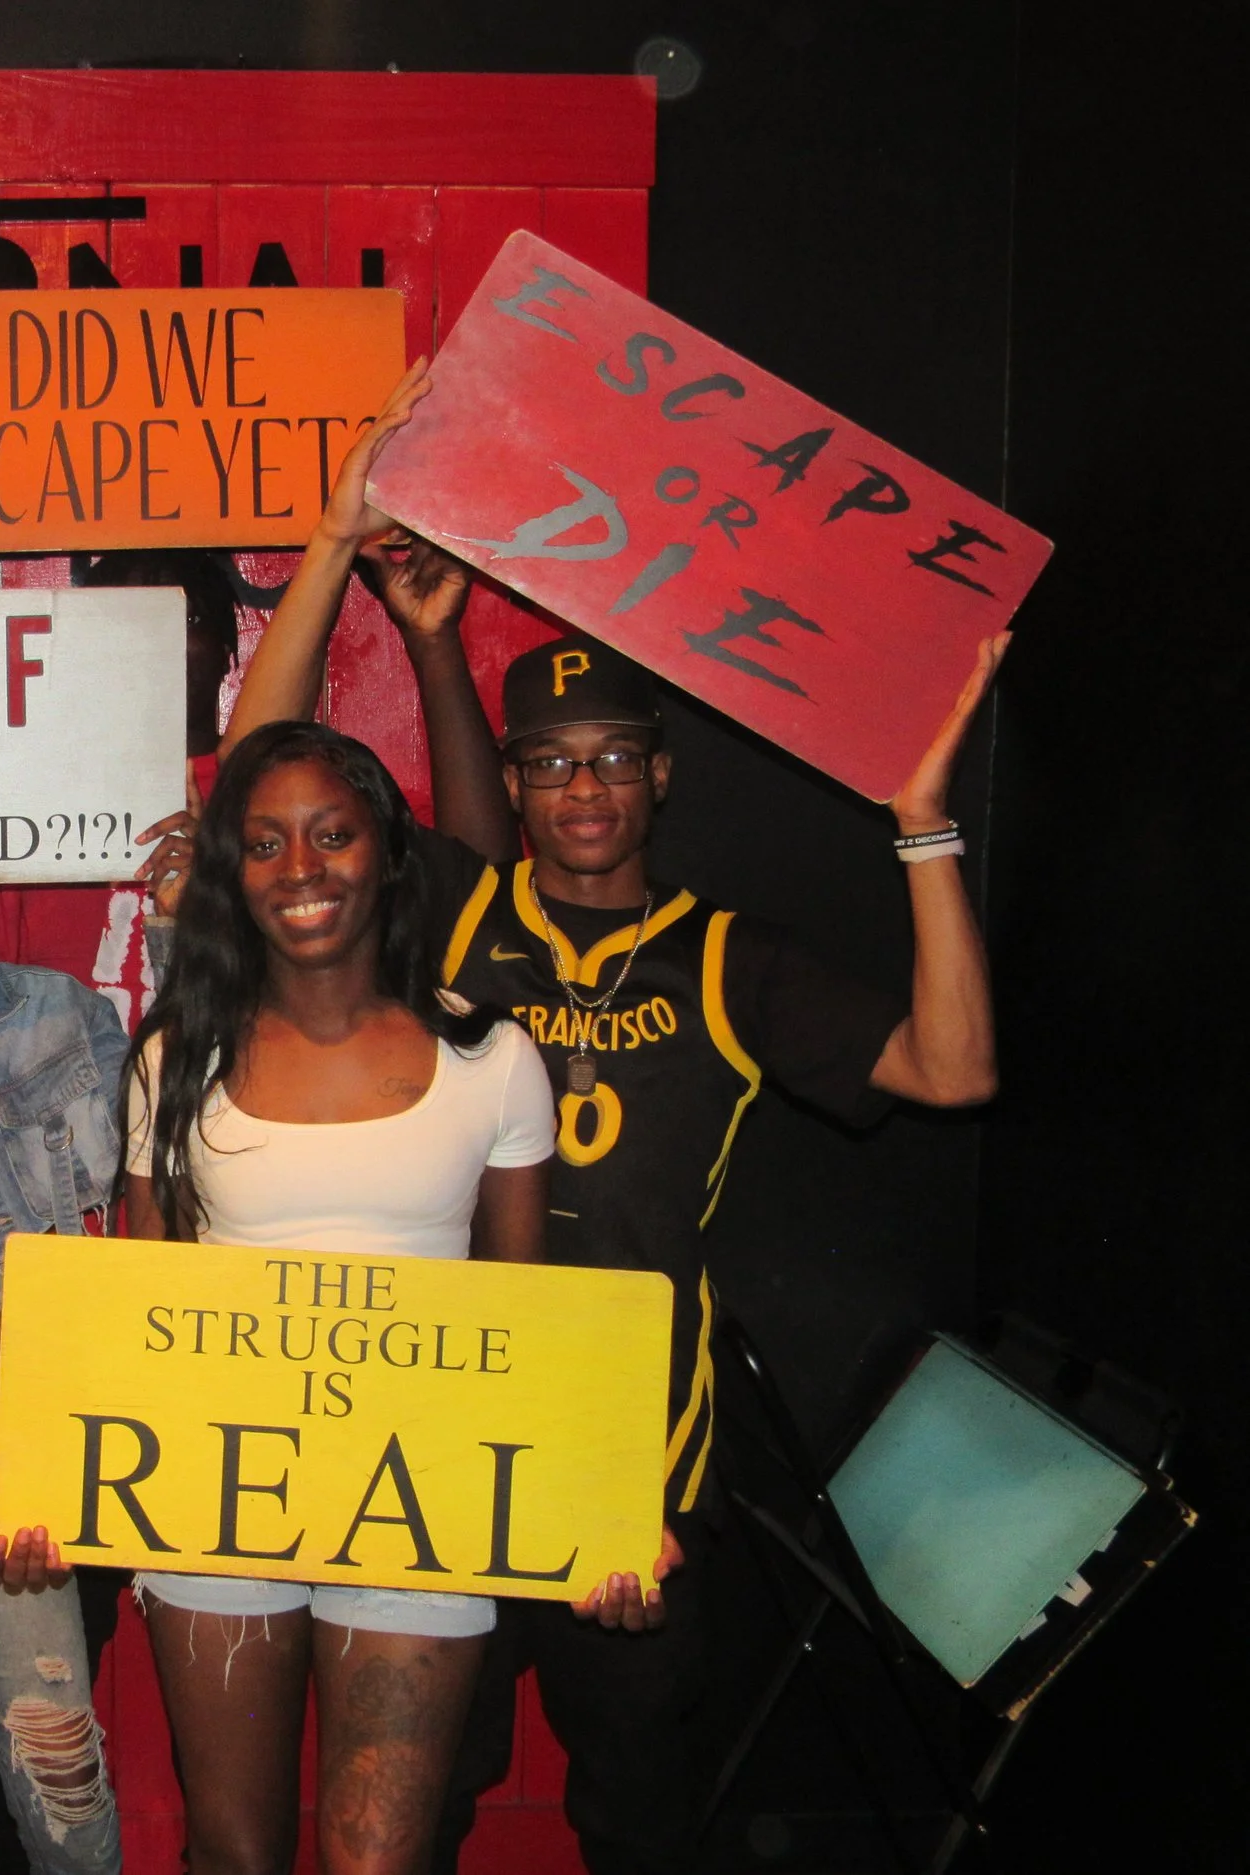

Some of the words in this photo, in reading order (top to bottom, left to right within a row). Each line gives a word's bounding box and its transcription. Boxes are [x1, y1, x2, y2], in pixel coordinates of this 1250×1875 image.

[9, 308, 118, 411] DID
[139, 308, 267, 409] WE
[202, 416, 377, 519] YET
[493, 265, 1006, 601] ESCAPE
[654, 465, 758, 549] OR
[442, 460, 836, 705] DIE
[551, 648, 592, 697] P
[265, 1259, 398, 1312] THE
[145, 1305, 513, 1375] STRUGGLE
[298, 1370, 354, 1418] IS
[62, 1412, 580, 1583] REAL
